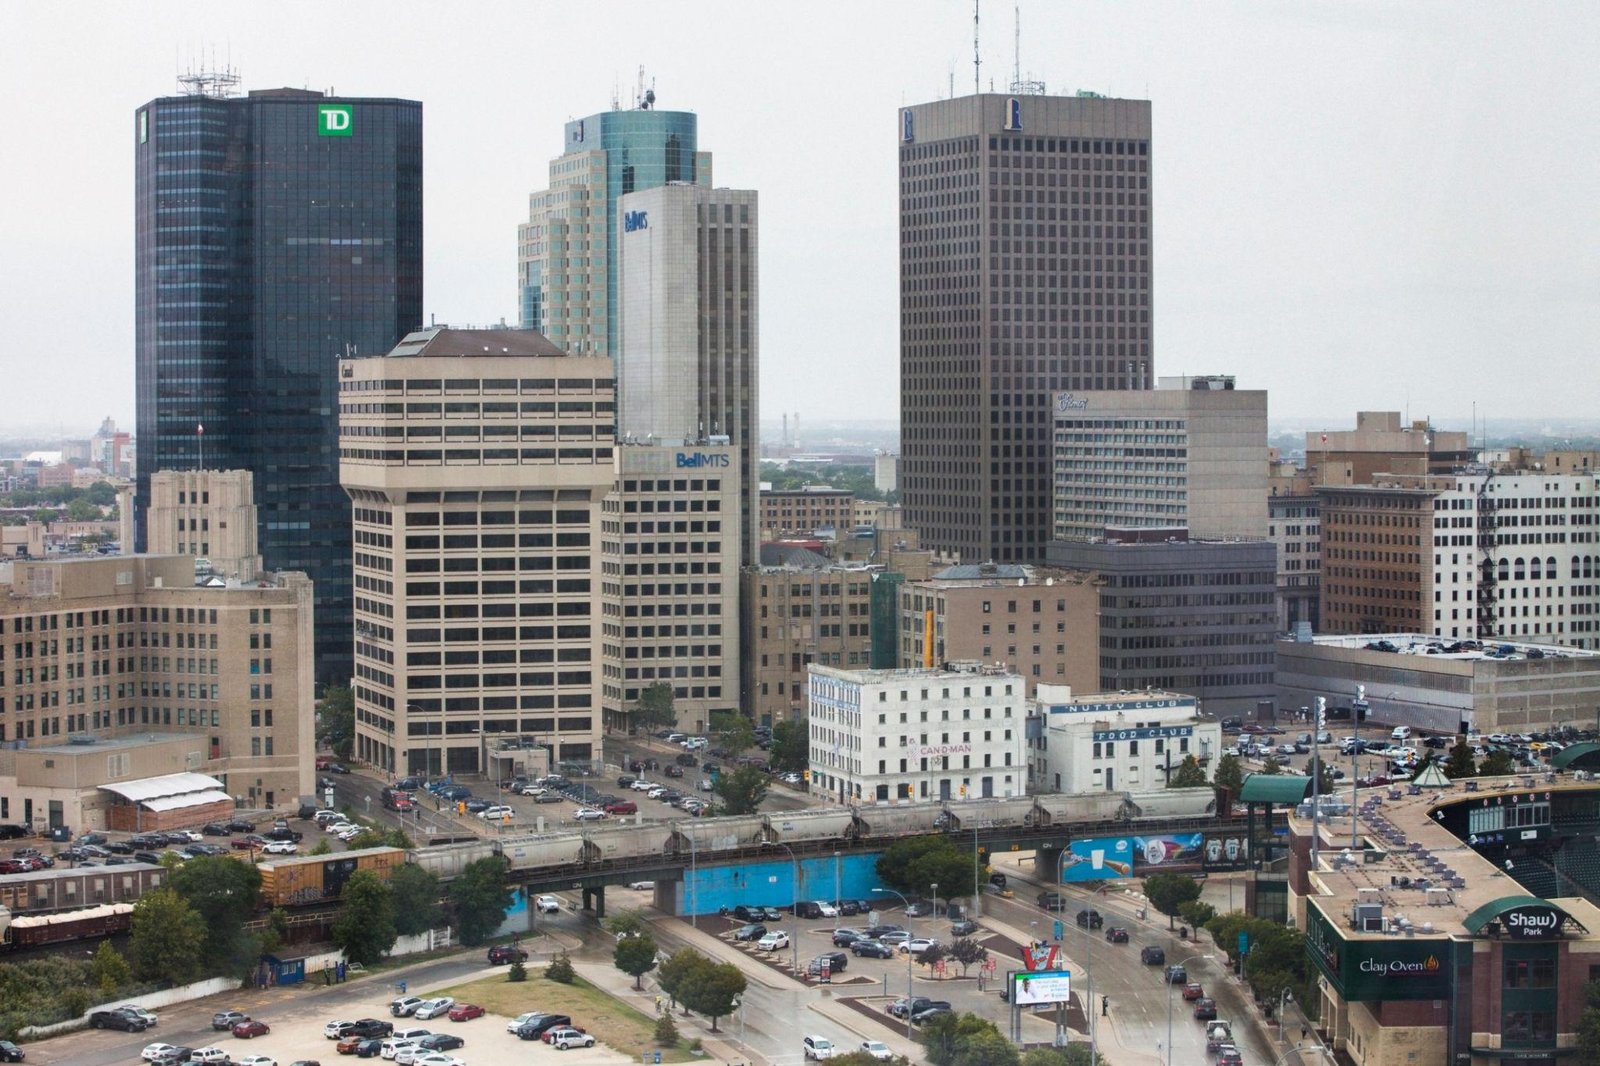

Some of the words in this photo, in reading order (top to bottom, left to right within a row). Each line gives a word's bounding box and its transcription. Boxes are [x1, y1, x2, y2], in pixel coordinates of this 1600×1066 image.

[321, 109, 350, 130] TD
[1523, 927, 1543, 936] Park
[1359, 957, 1387, 977] Clay
[1390, 960, 1424, 972] Oven
